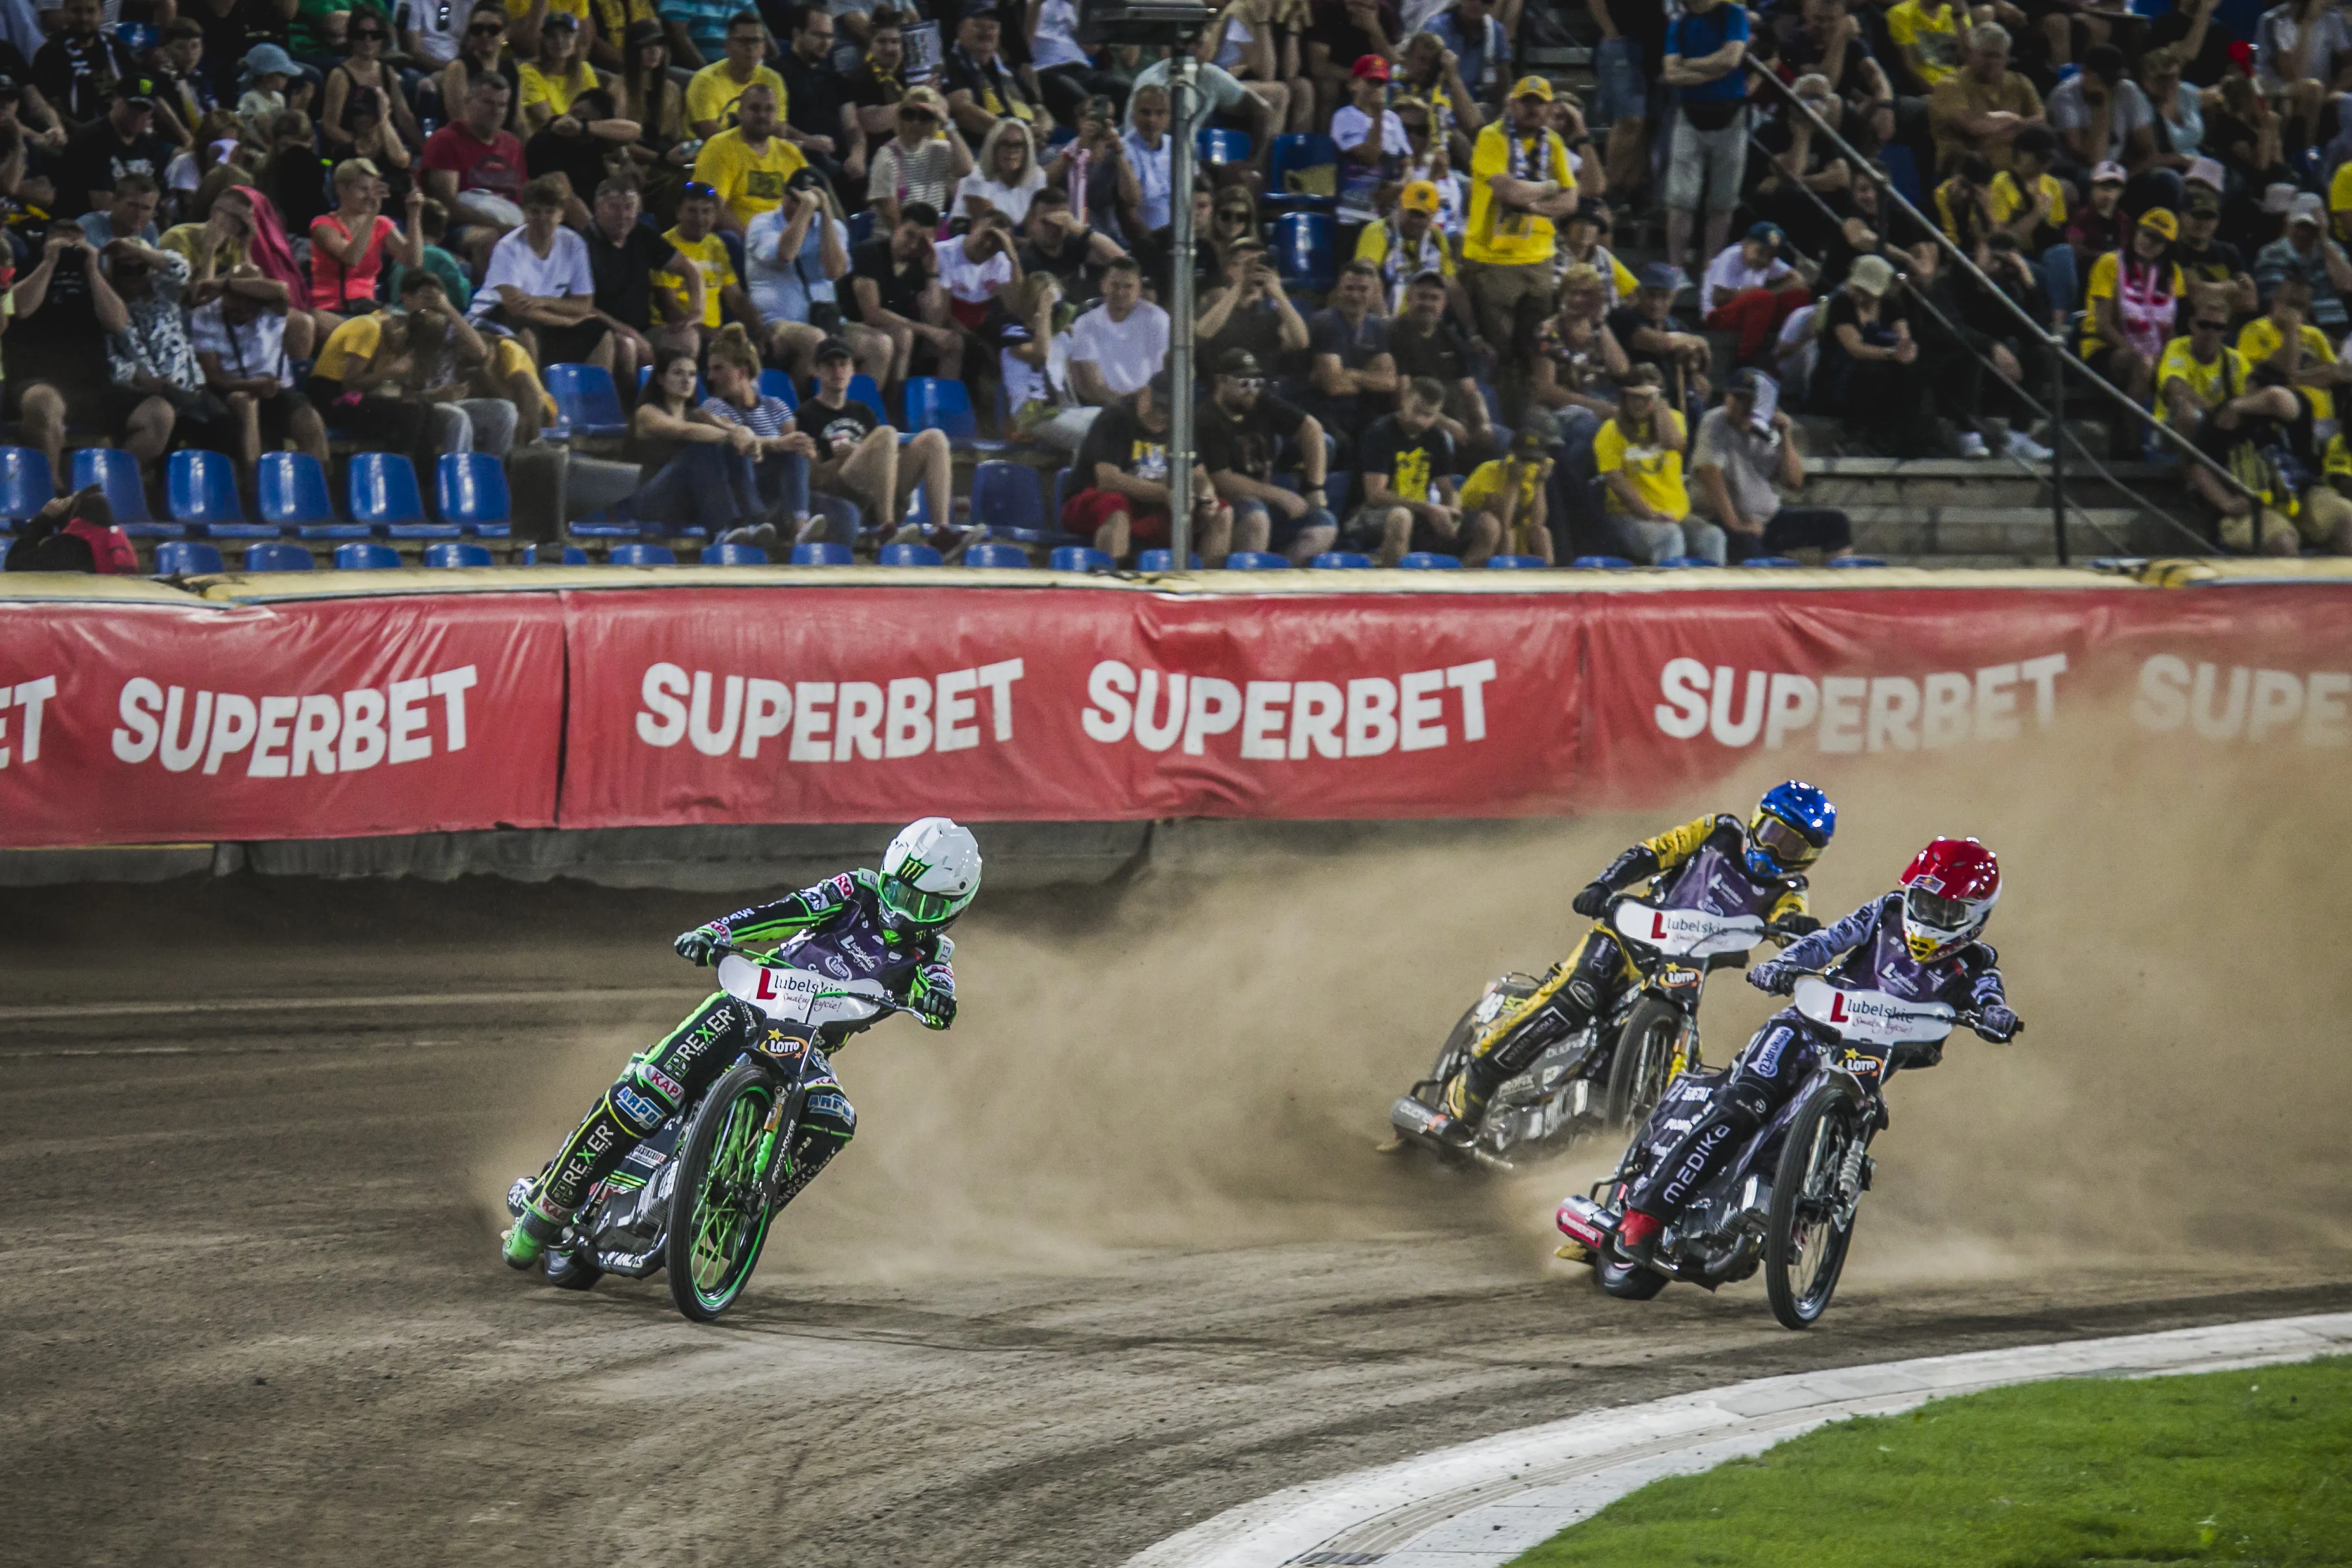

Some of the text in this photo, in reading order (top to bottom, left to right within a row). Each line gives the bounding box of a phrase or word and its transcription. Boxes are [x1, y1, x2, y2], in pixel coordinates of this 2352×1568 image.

[111, 664, 477, 778] SUPERBET
[636, 658, 1024, 762] SUPERBET
[1081, 659, 1496, 760] SUPERBET
[1654, 652, 2068, 753] SUPERBET
[2132, 654, 2352, 746] SUPE
[774, 975, 842, 999] lubelskie
[1668, 972, 1696, 984] LOTTO
[676, 1009, 736, 1061] REXER
[1847, 999, 1914, 1024] lubelskie
[770, 1039, 800, 1053] LOTTO
[1847, 1058, 1877, 1072] LOTTO
[562, 1125, 614, 1186] REXER
